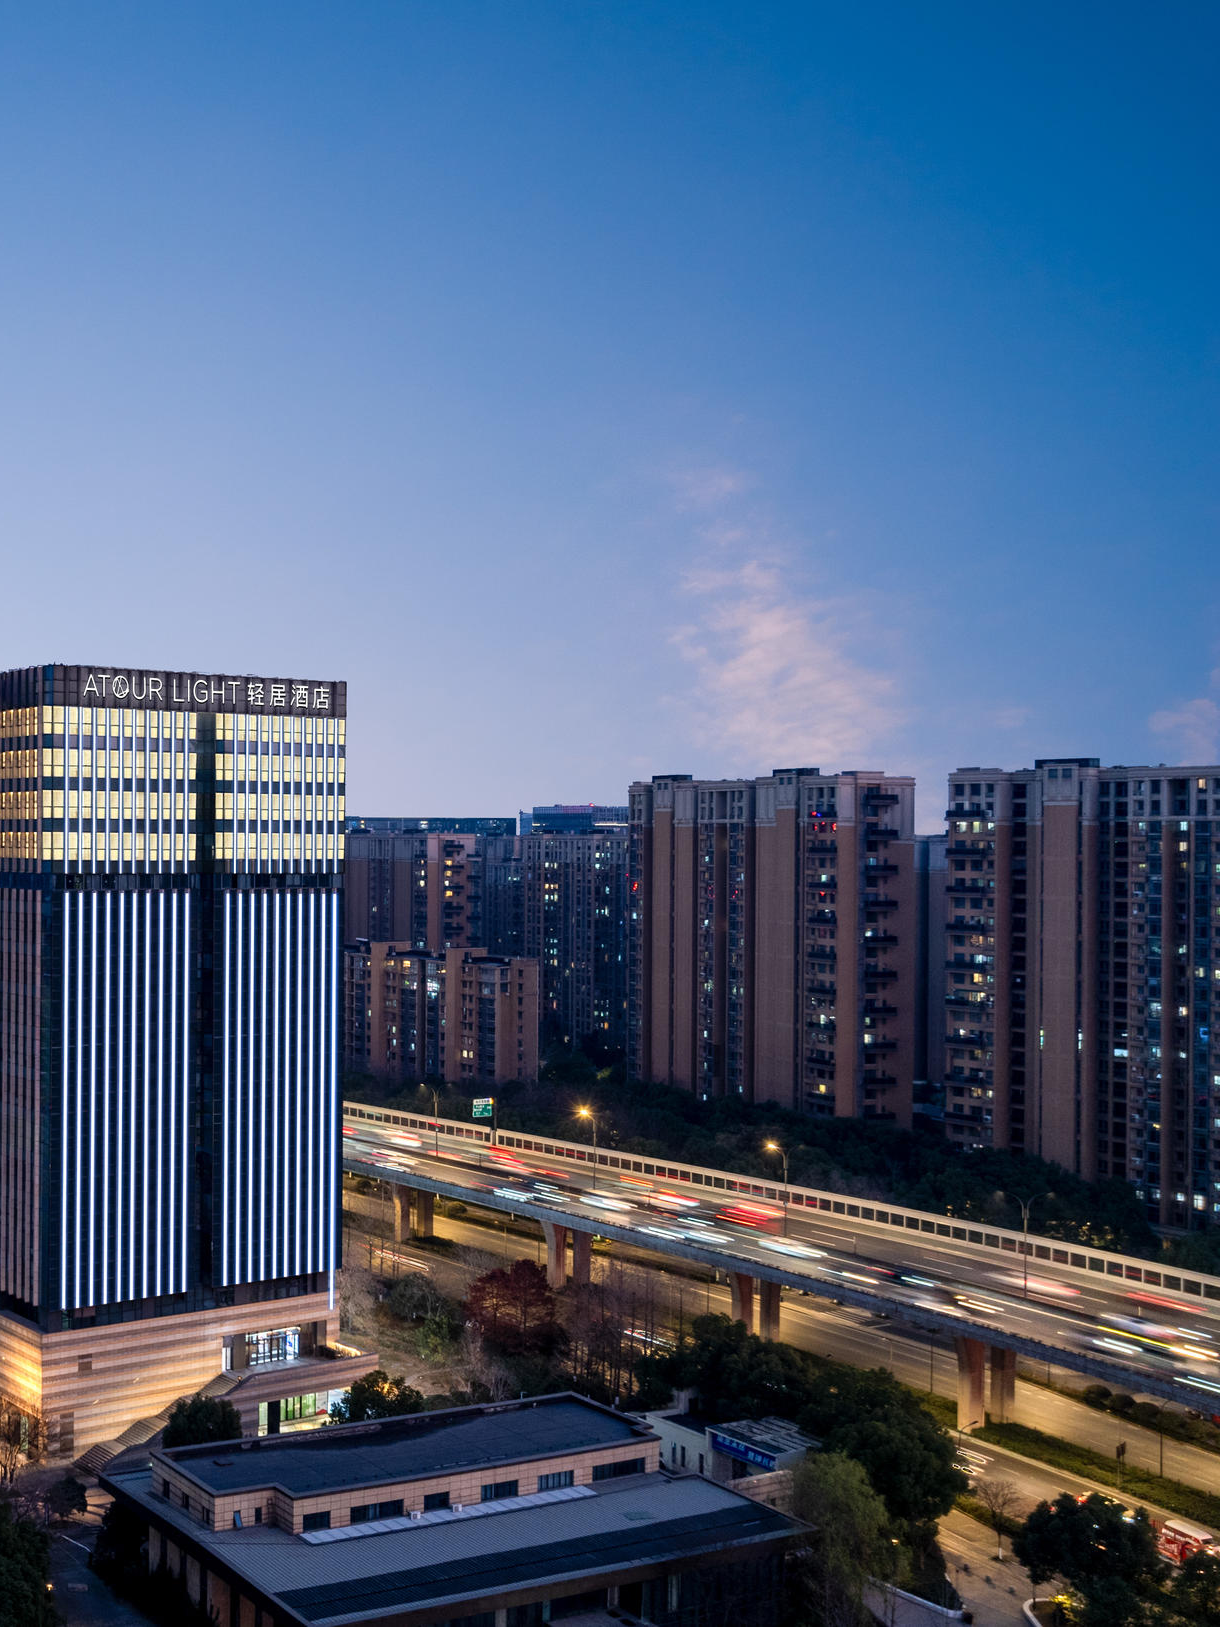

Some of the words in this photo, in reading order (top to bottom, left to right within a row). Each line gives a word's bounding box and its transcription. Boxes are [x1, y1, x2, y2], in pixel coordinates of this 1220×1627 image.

[83, 674, 163, 700] ATOUR
[173, 678, 240, 704] LIGHT
[247, 682, 330, 709] 轻居酒店
